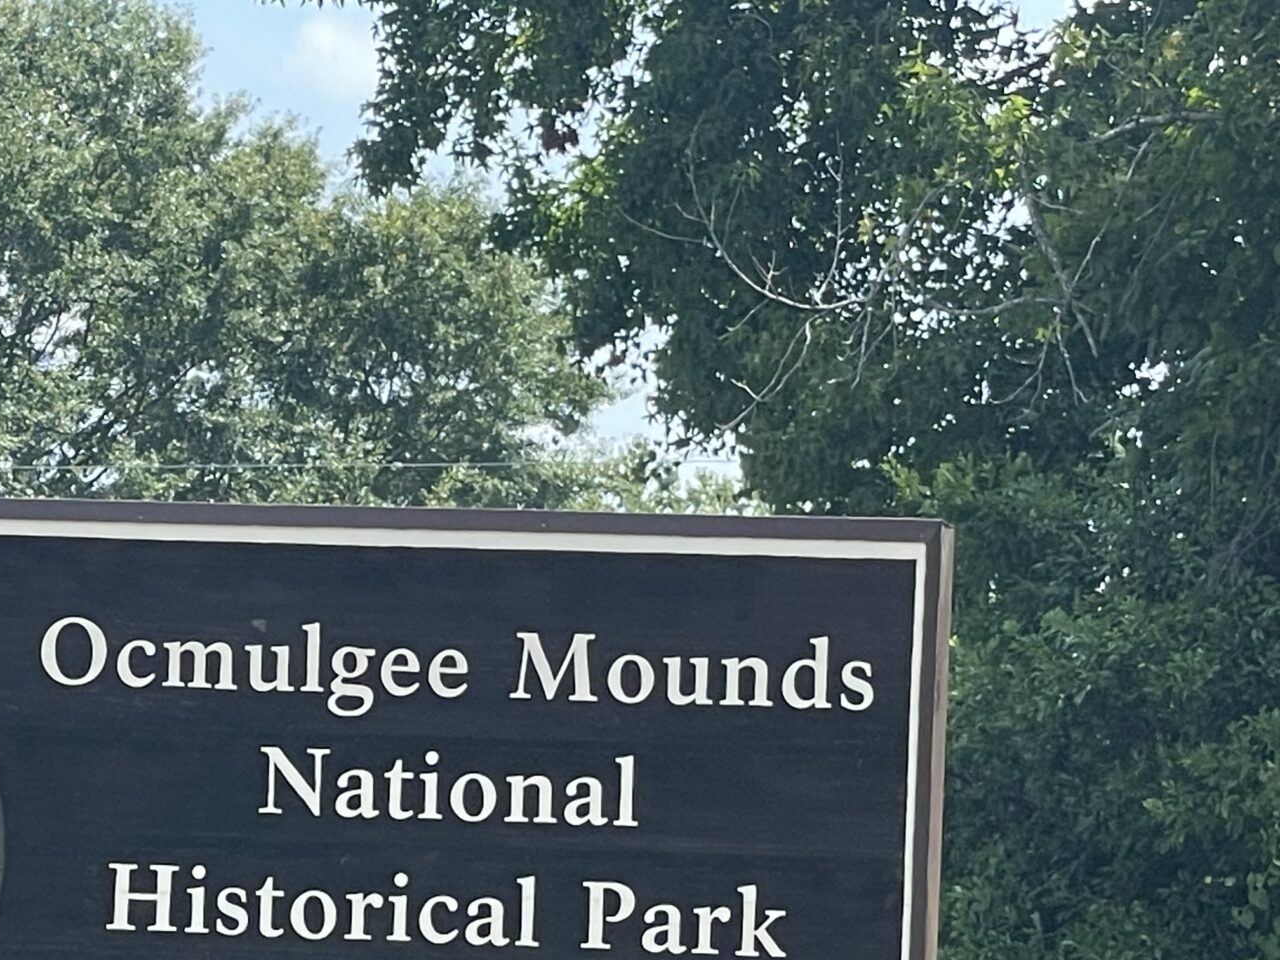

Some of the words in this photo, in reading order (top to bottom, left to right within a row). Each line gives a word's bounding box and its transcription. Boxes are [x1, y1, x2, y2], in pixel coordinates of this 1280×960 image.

[40, 616, 469, 717] Ocmulgee
[509, 632, 874, 711] Mounds
[258, 746, 639, 827] National
[105, 862, 540, 948] Historical
[580, 881, 787, 958] Park
